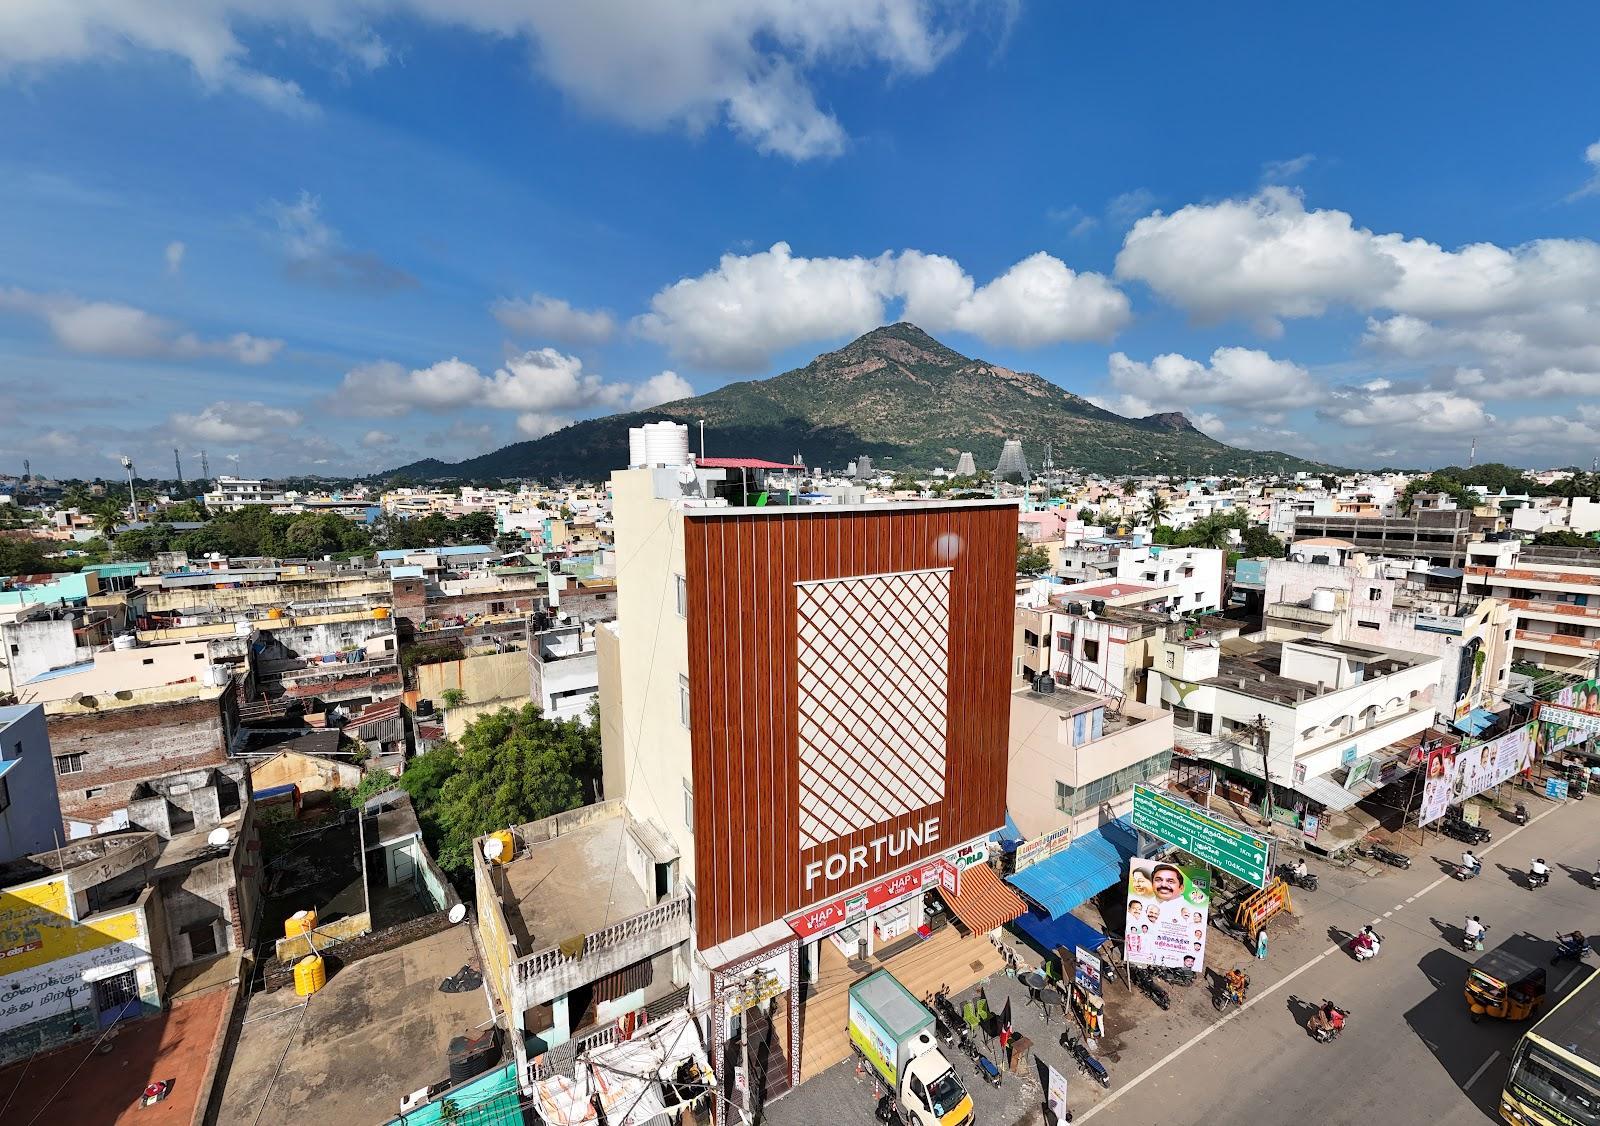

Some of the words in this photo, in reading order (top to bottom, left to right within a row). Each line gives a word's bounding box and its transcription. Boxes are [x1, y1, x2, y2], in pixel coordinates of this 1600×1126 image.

[1197, 830, 1216, 844] Temple
[805, 817, 940, 891] FORTUNE
[957, 845, 973, 858] TEA
[1225, 859, 1246, 874] 104Km
[892, 875, 911, 889] HAP
[810, 908, 833, 925] HAP
